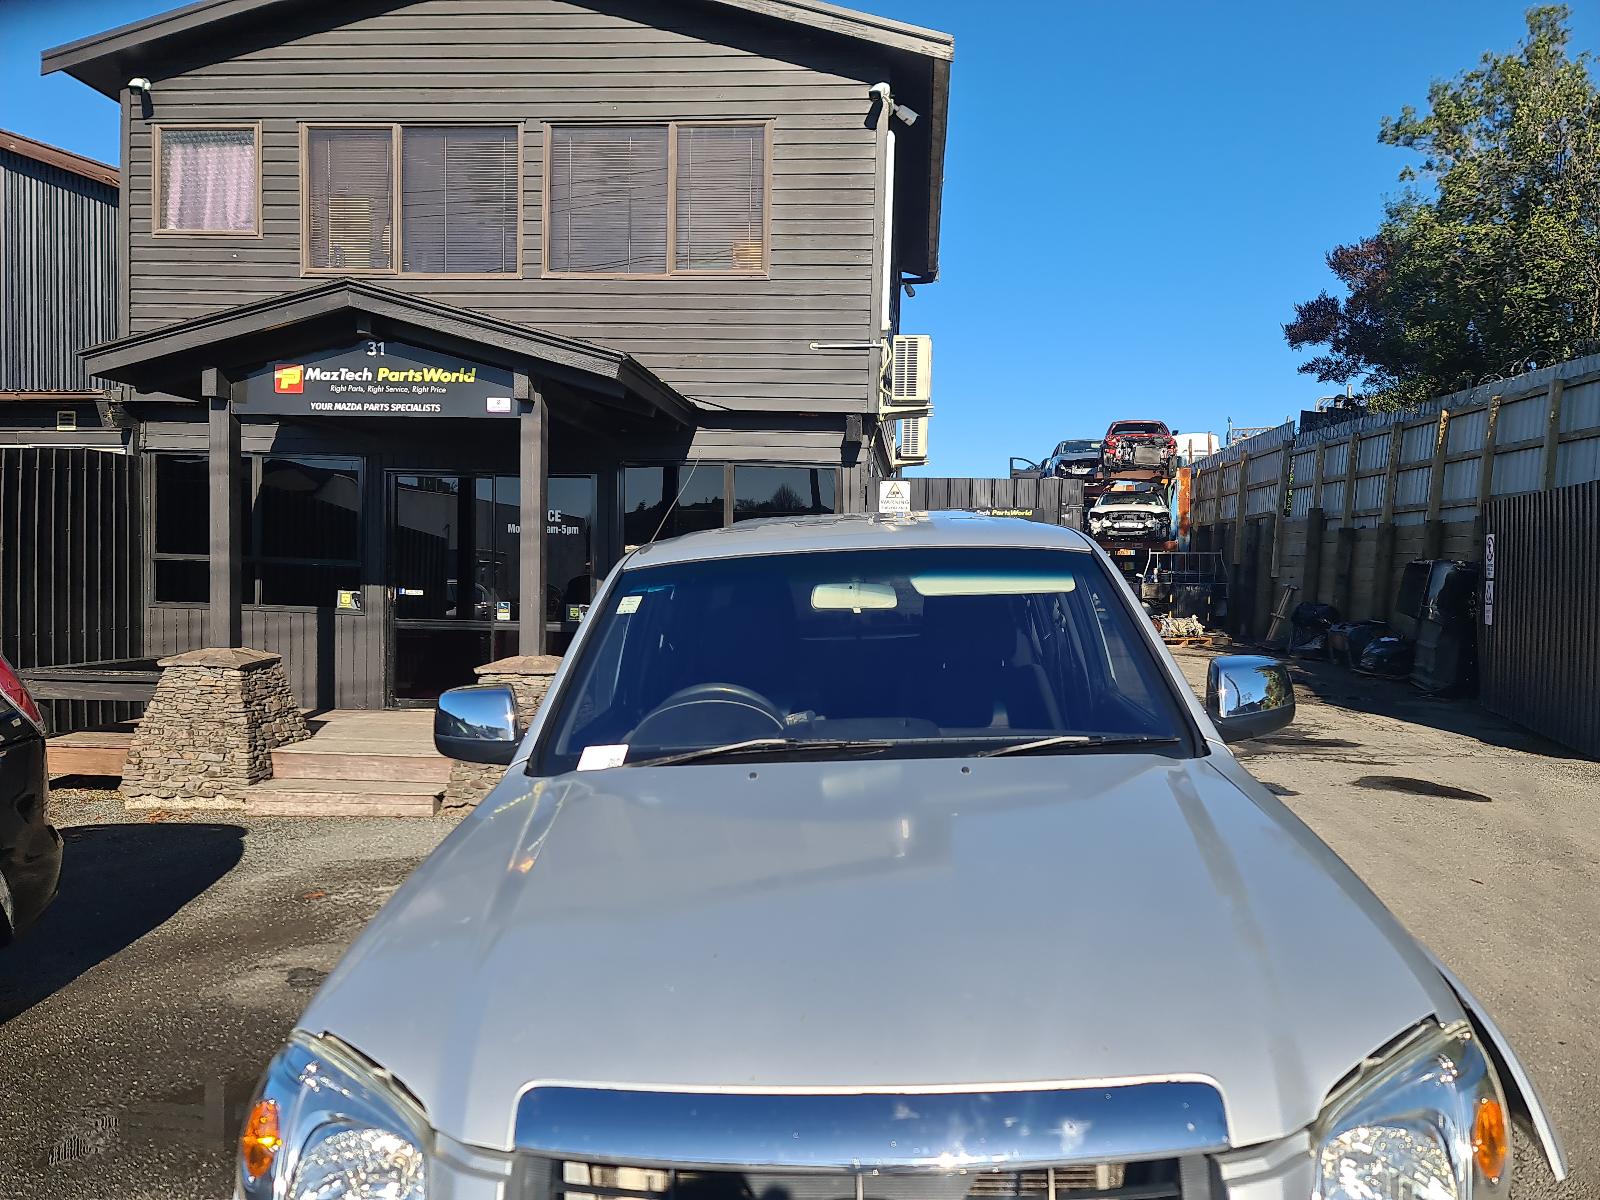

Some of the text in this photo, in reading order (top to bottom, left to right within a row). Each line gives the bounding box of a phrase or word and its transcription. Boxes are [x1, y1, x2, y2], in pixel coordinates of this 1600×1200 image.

[367, 341, 385, 356] 31
[305, 367, 477, 383] MazTech PartsWorld
[330, 384, 447, 395] Right Parts, Right Service, Right Price
[310, 402, 441, 412] YOUR MAZDA PARTS SPECIALISTS
[547, 510, 561, 522] CE
[507, 524, 579, 535] Mo am-5pm
